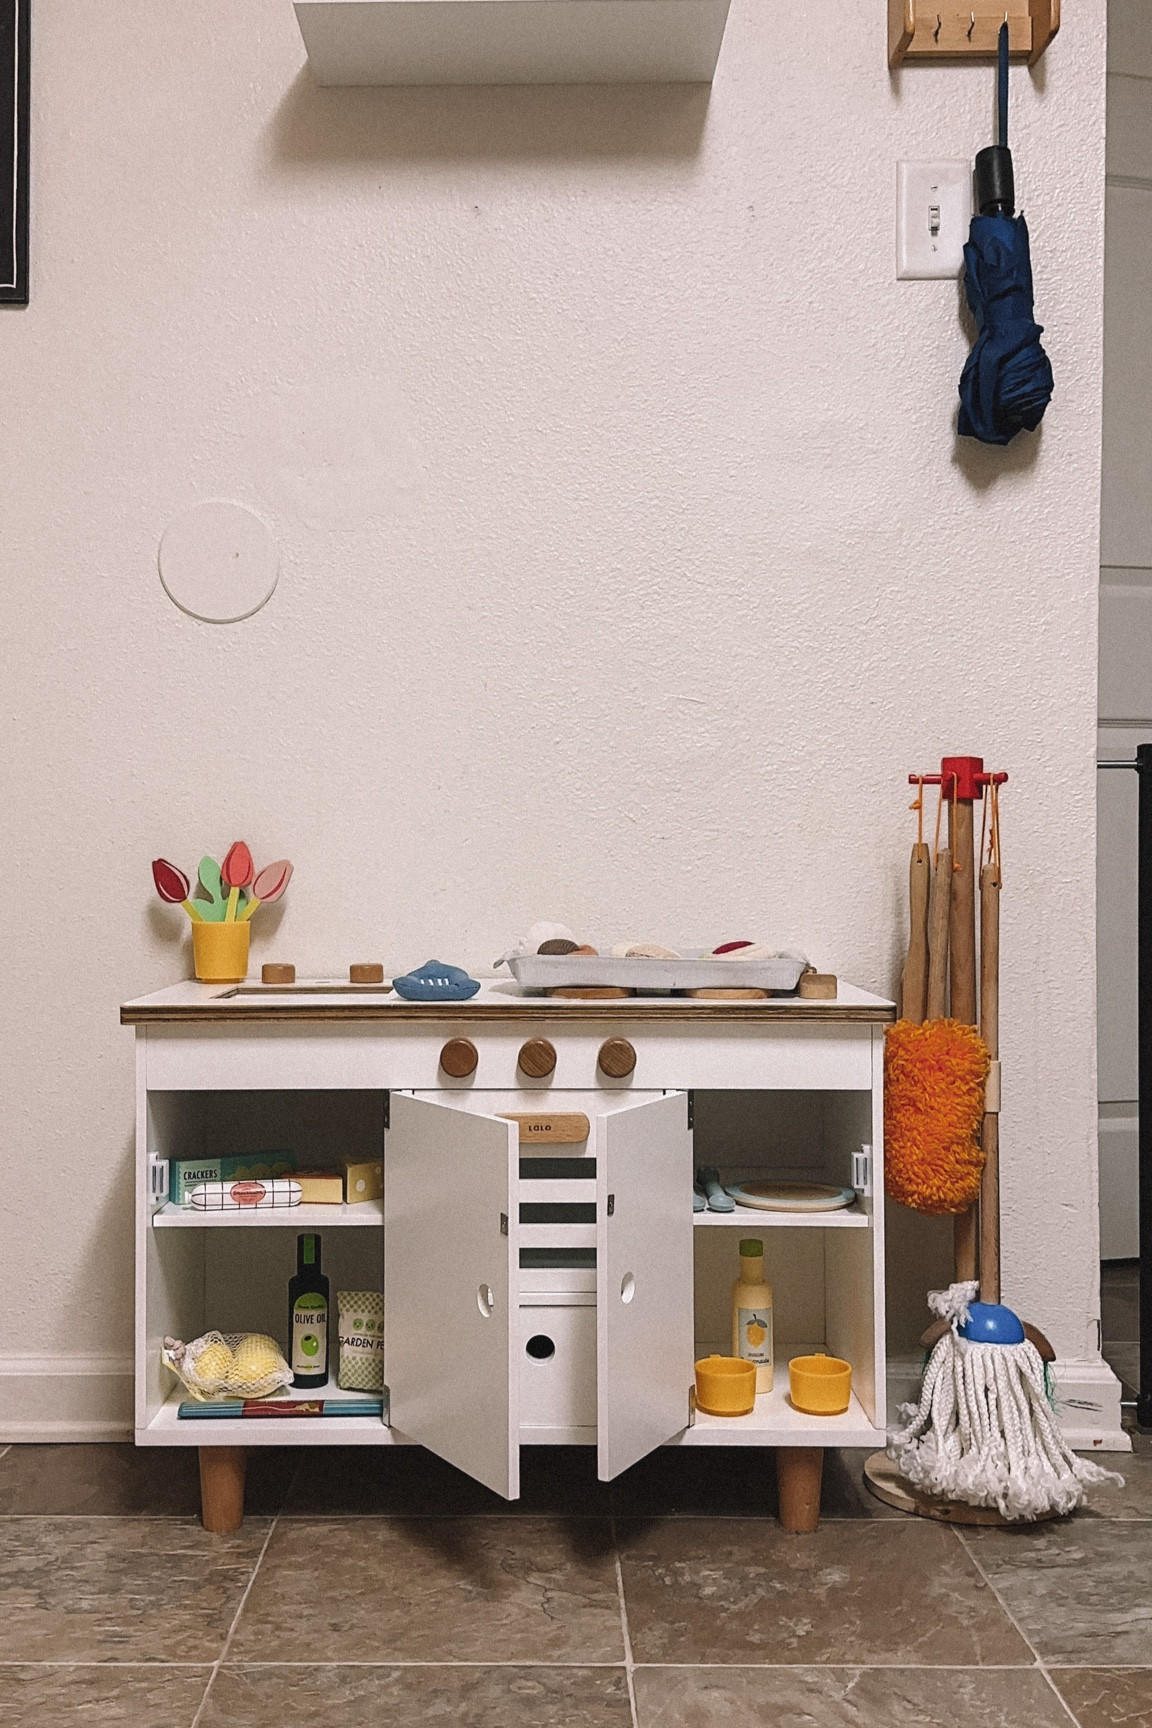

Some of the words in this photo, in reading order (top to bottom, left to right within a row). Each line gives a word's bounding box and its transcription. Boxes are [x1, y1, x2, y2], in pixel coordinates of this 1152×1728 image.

[183, 1169, 218, 1180] CRACKERS
[294, 1313, 315, 1324] OLIVE
[316, 1312, 326, 1323] OIL
[339, 1336, 374, 1349] GARDEN
[376, 1341, 385, 1350] PE
